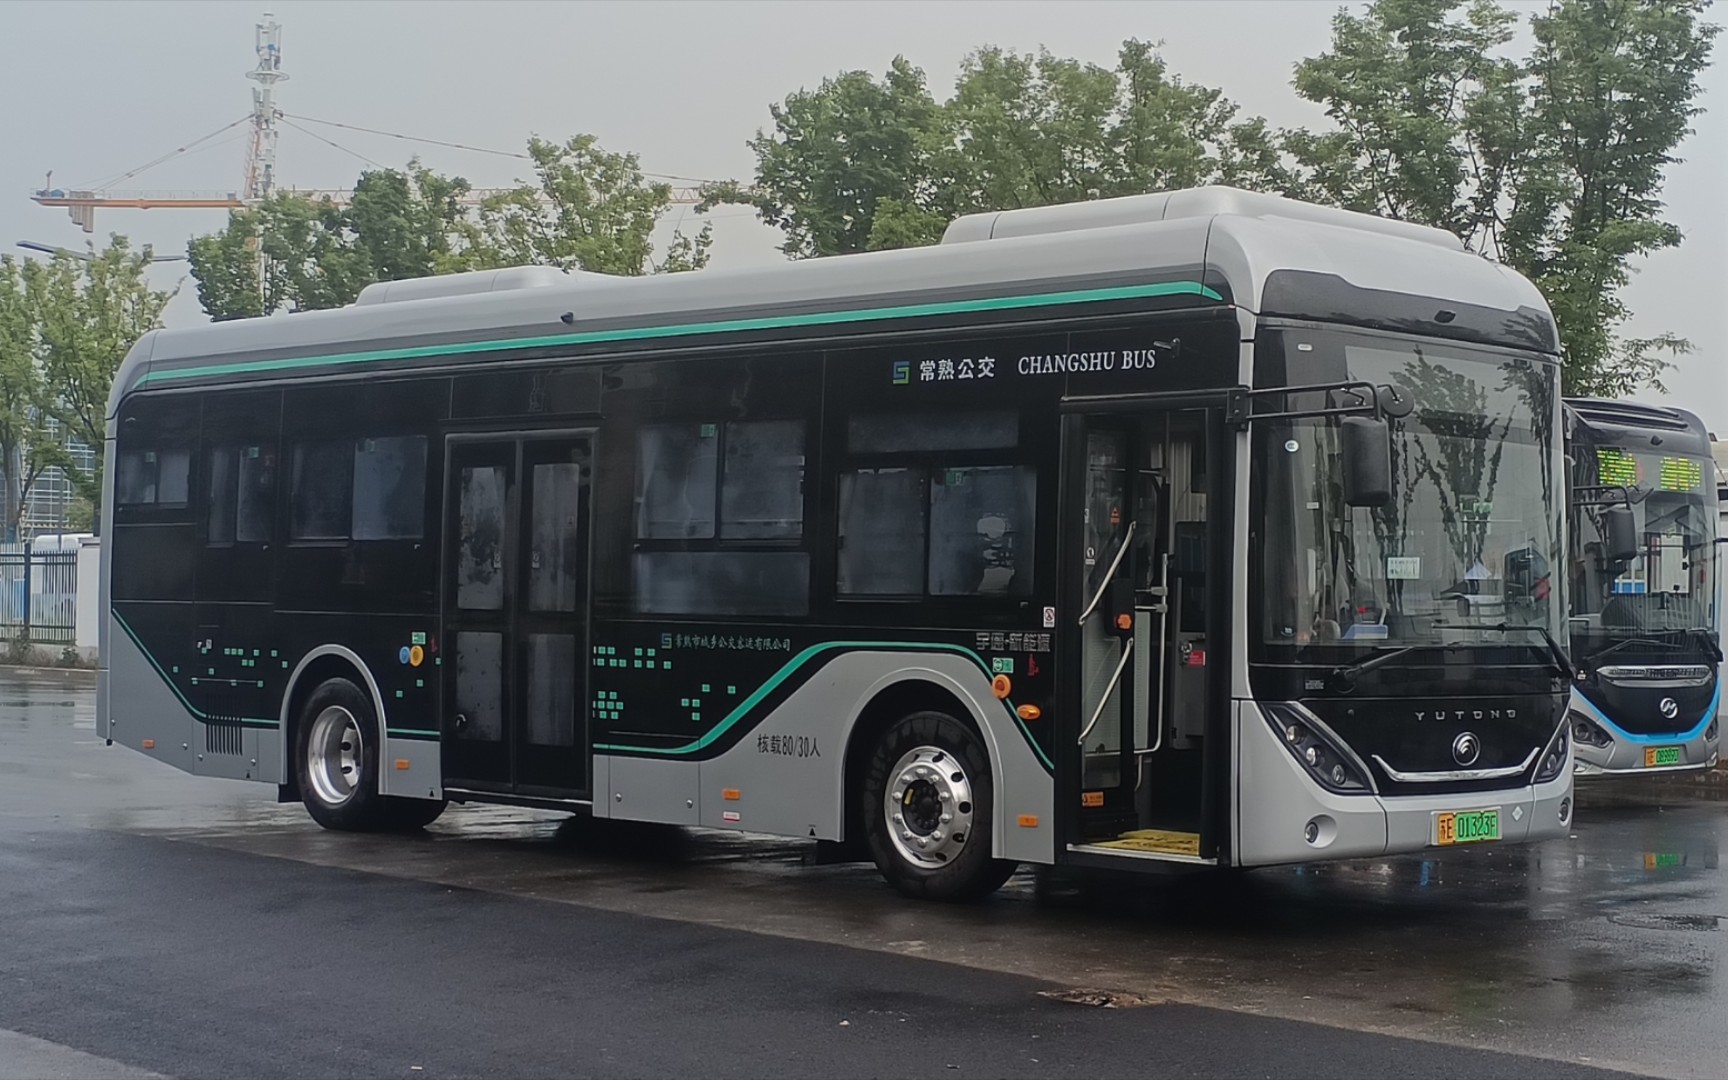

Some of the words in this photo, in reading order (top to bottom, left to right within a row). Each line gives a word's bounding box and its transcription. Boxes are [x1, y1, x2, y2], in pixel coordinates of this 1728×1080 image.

[920, 356, 996, 381] 常熟公交
[1018, 351, 1116, 375] CHANGSHU
[1121, 349, 1156, 370] BUS
[1414, 709, 1516, 721] YUTONG
